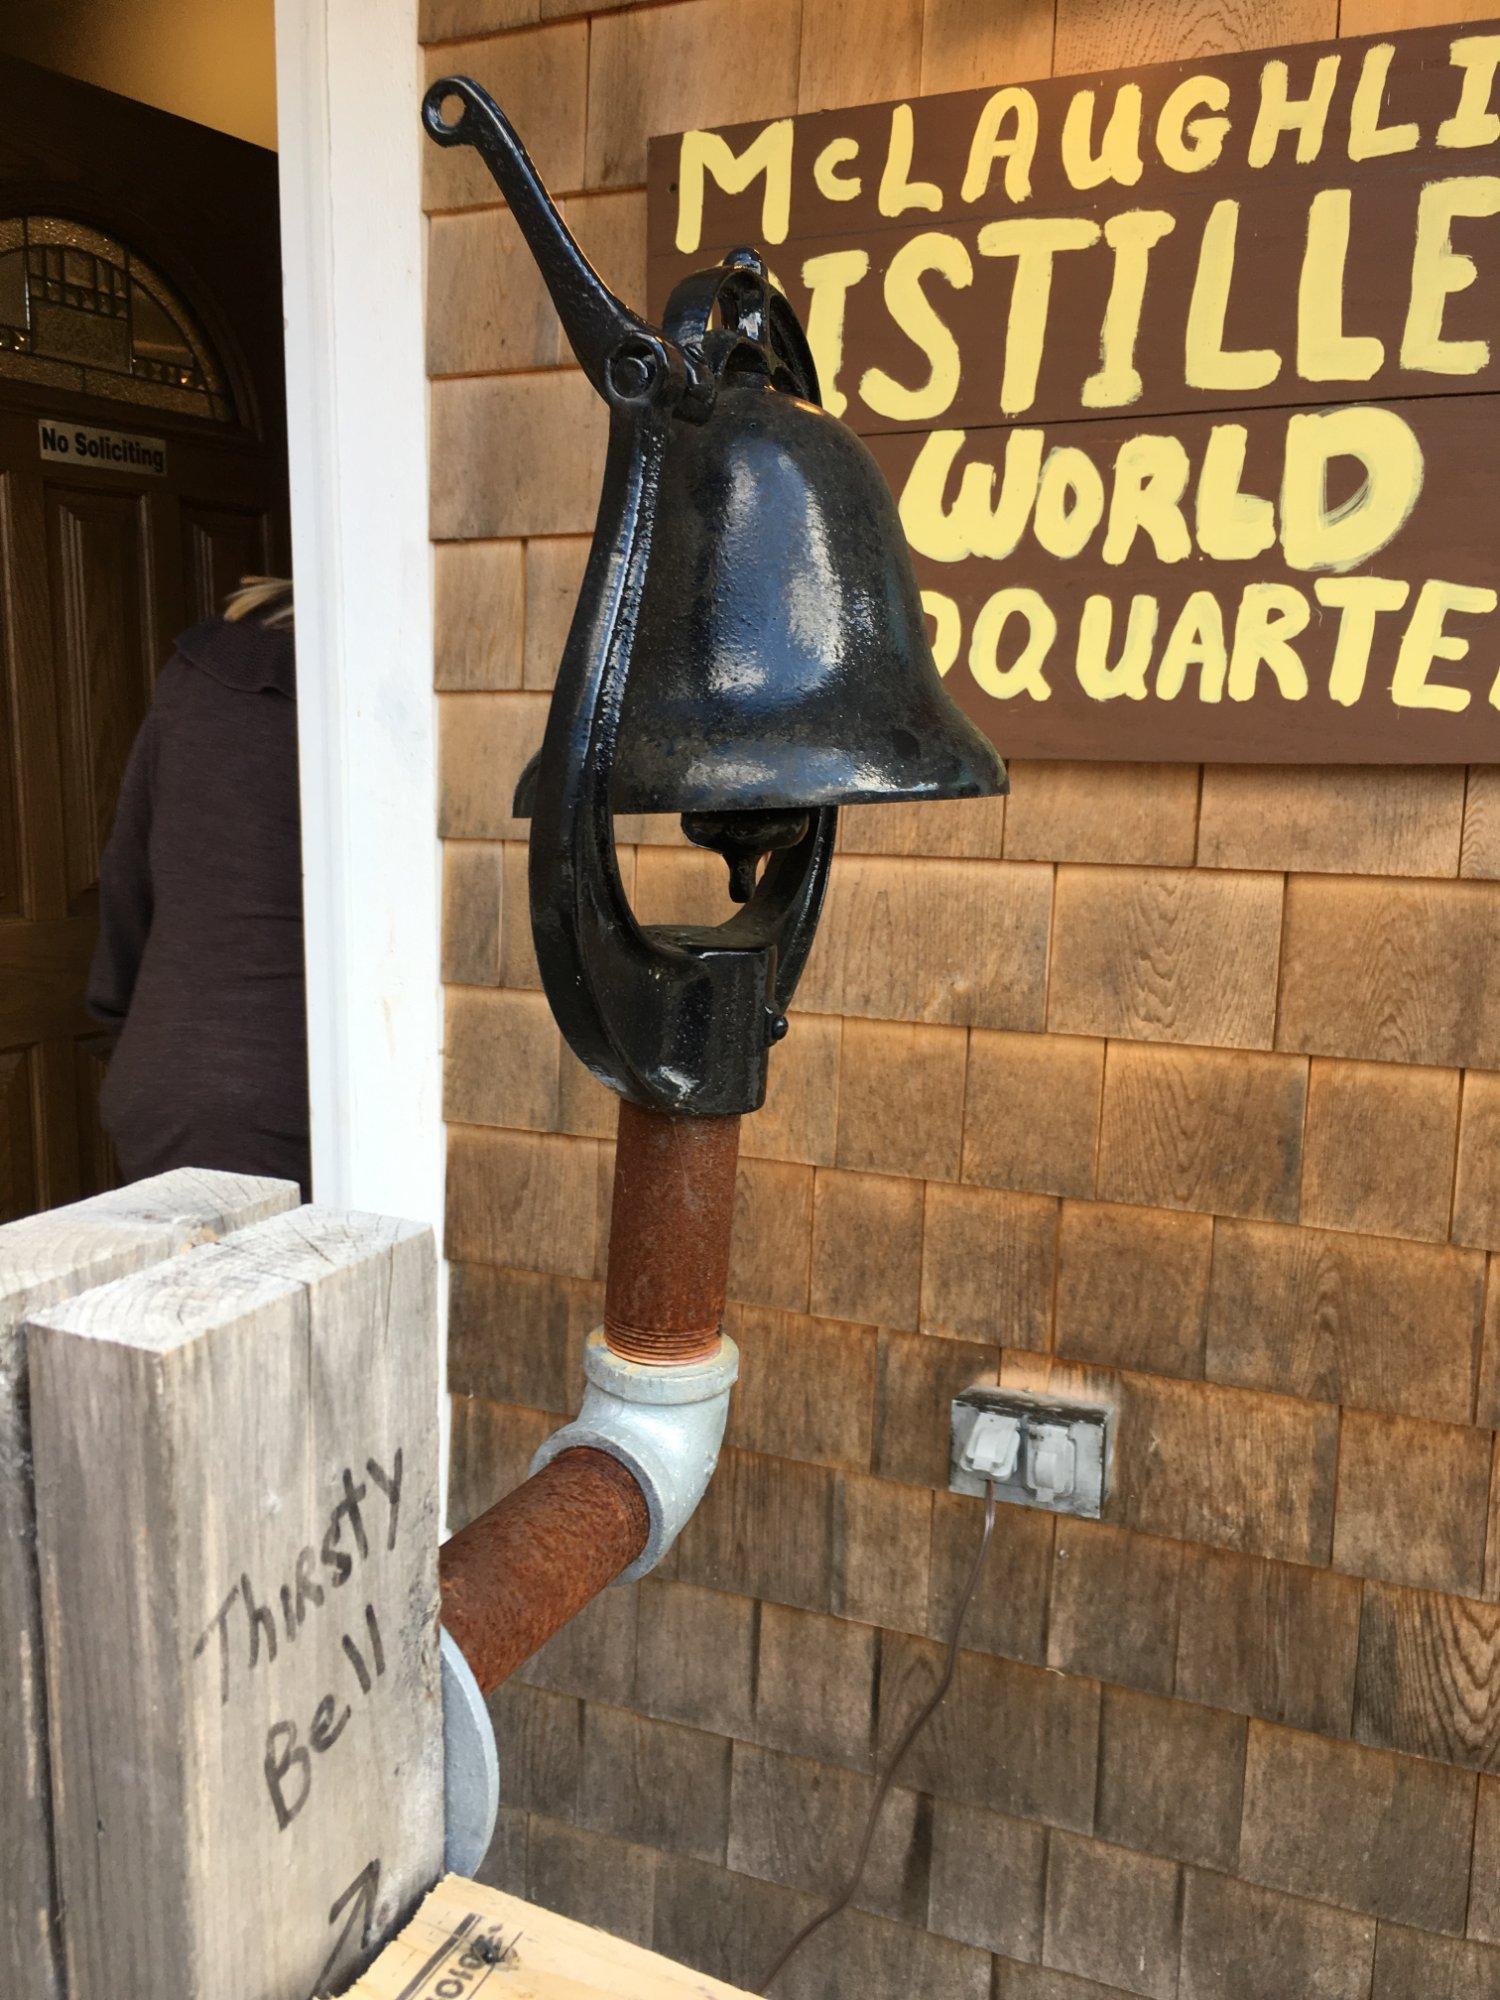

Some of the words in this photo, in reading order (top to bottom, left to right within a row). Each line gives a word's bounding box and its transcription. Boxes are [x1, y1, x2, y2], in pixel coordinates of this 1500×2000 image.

[698, 175, 1500, 420] ISTILLE
[41, 427, 69, 453] No
[74, 432, 164, 472] Soliciting
[898, 405, 1425, 574] WORLD
[264, 1603, 385, 1831] Bell
